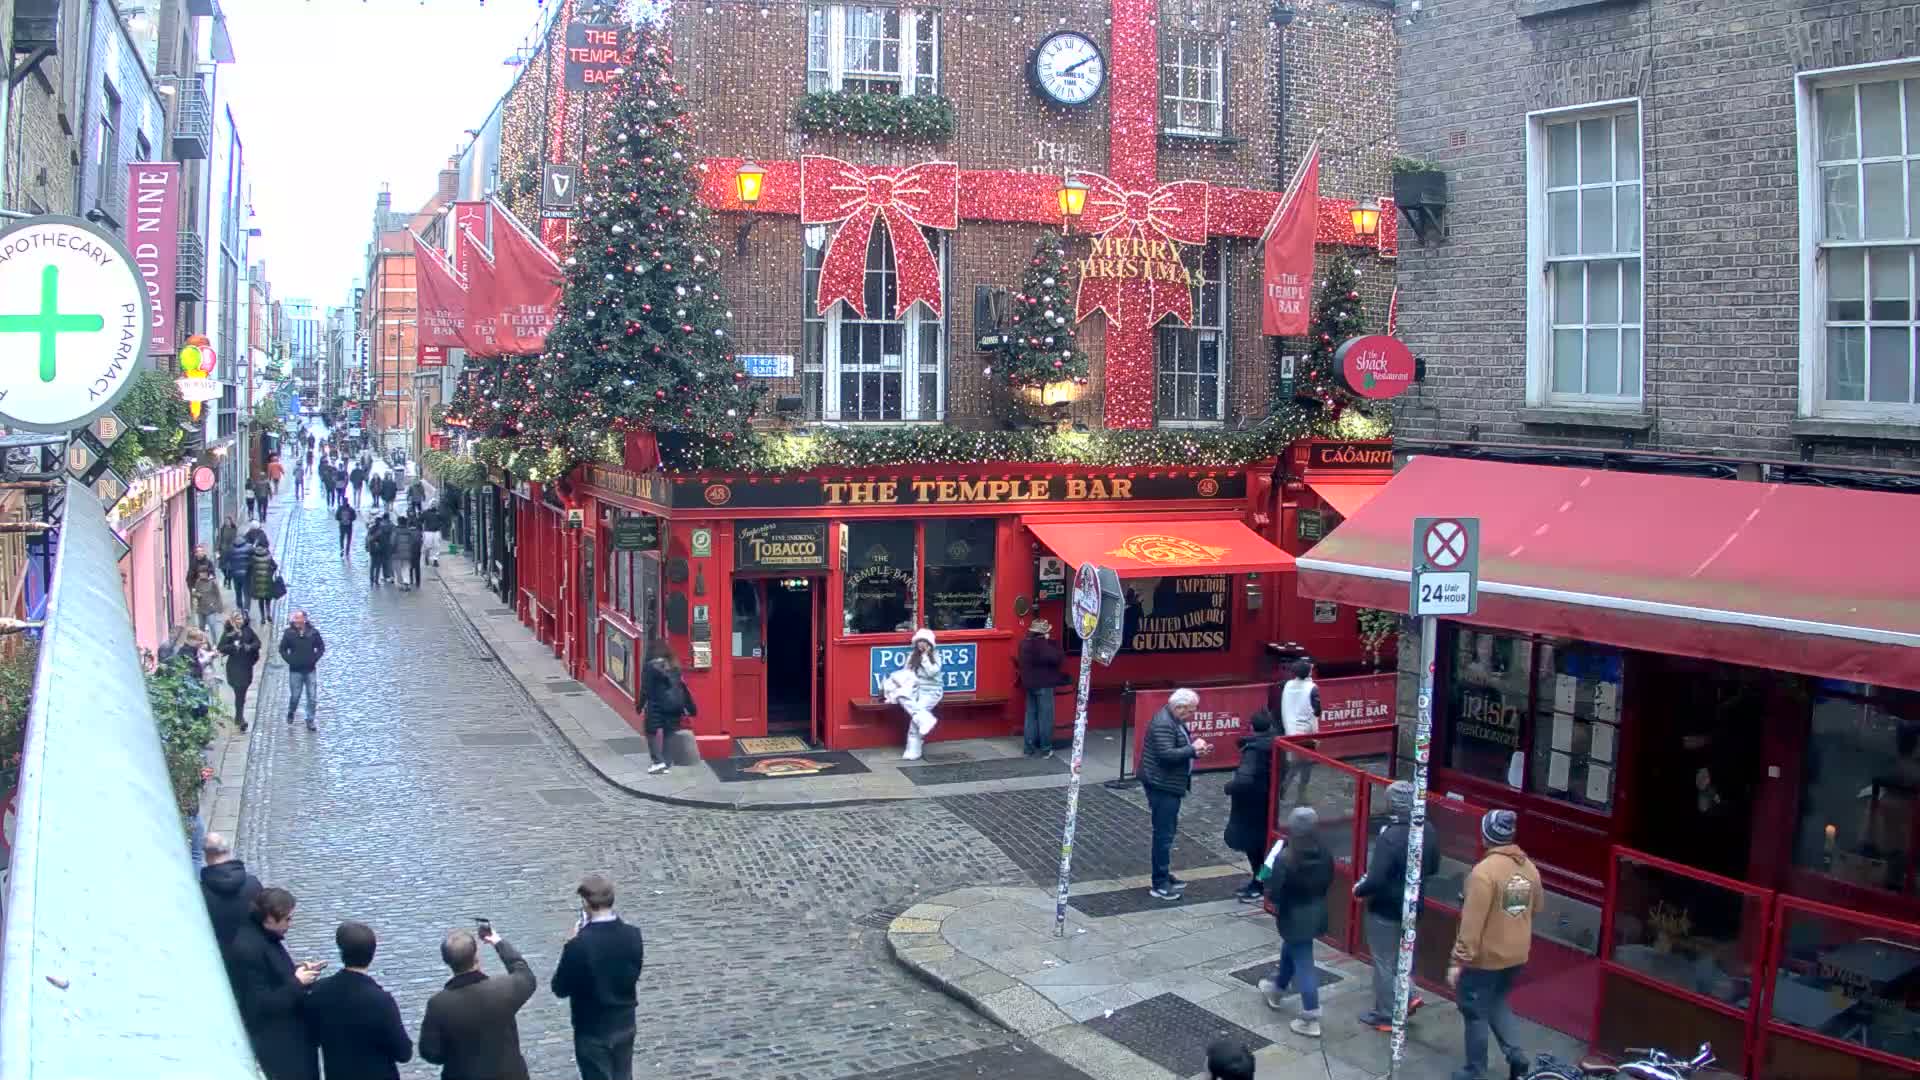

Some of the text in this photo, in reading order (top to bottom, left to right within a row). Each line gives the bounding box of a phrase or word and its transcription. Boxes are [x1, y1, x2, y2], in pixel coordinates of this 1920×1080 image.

[585, 30, 618, 45] THE
[136, 171, 169, 233] NINE
[542, 210, 575, 218] GUINNE
[1088, 237, 1186, 262] MERRY
[1066, 259, 1206, 287] CHRISTMAS
[1282, 273, 1298, 285] THE
[1269, 284, 1304, 299] TEMPL
[519, 304, 545, 313] THE
[1278, 300, 1300, 313] BAR
[503, 314, 553, 326] TEMPL
[516, 326, 548, 337] BAR
[88, 303, 136, 401] PHARMACY
[1373, 371, 1409, 381] Restaurant
[636, 478, 652, 499] BAR
[824, 478, 1133, 504] THE TEMPLE BAR
[749, 539, 816, 561] TOBACCO
[848, 566, 889, 587] TEMPLE
[1176, 578, 1225, 592] EMPEROR
[1212, 593, 1225, 607] OF
[1422, 584, 1443, 603] 24
[1444, 593, 1466, 603] HOUR
[1139, 609, 1225, 632] MALTED LIQUORS
[1132, 631, 1224, 650] GUINNESS
[880, 648, 969, 668] POR'S
[1344, 700, 1363, 709] THE
[1194, 711, 1213, 720] THE
[1321, 704, 1388, 721] TEMPLE BAR
[1216, 717, 1240, 729] BAR
